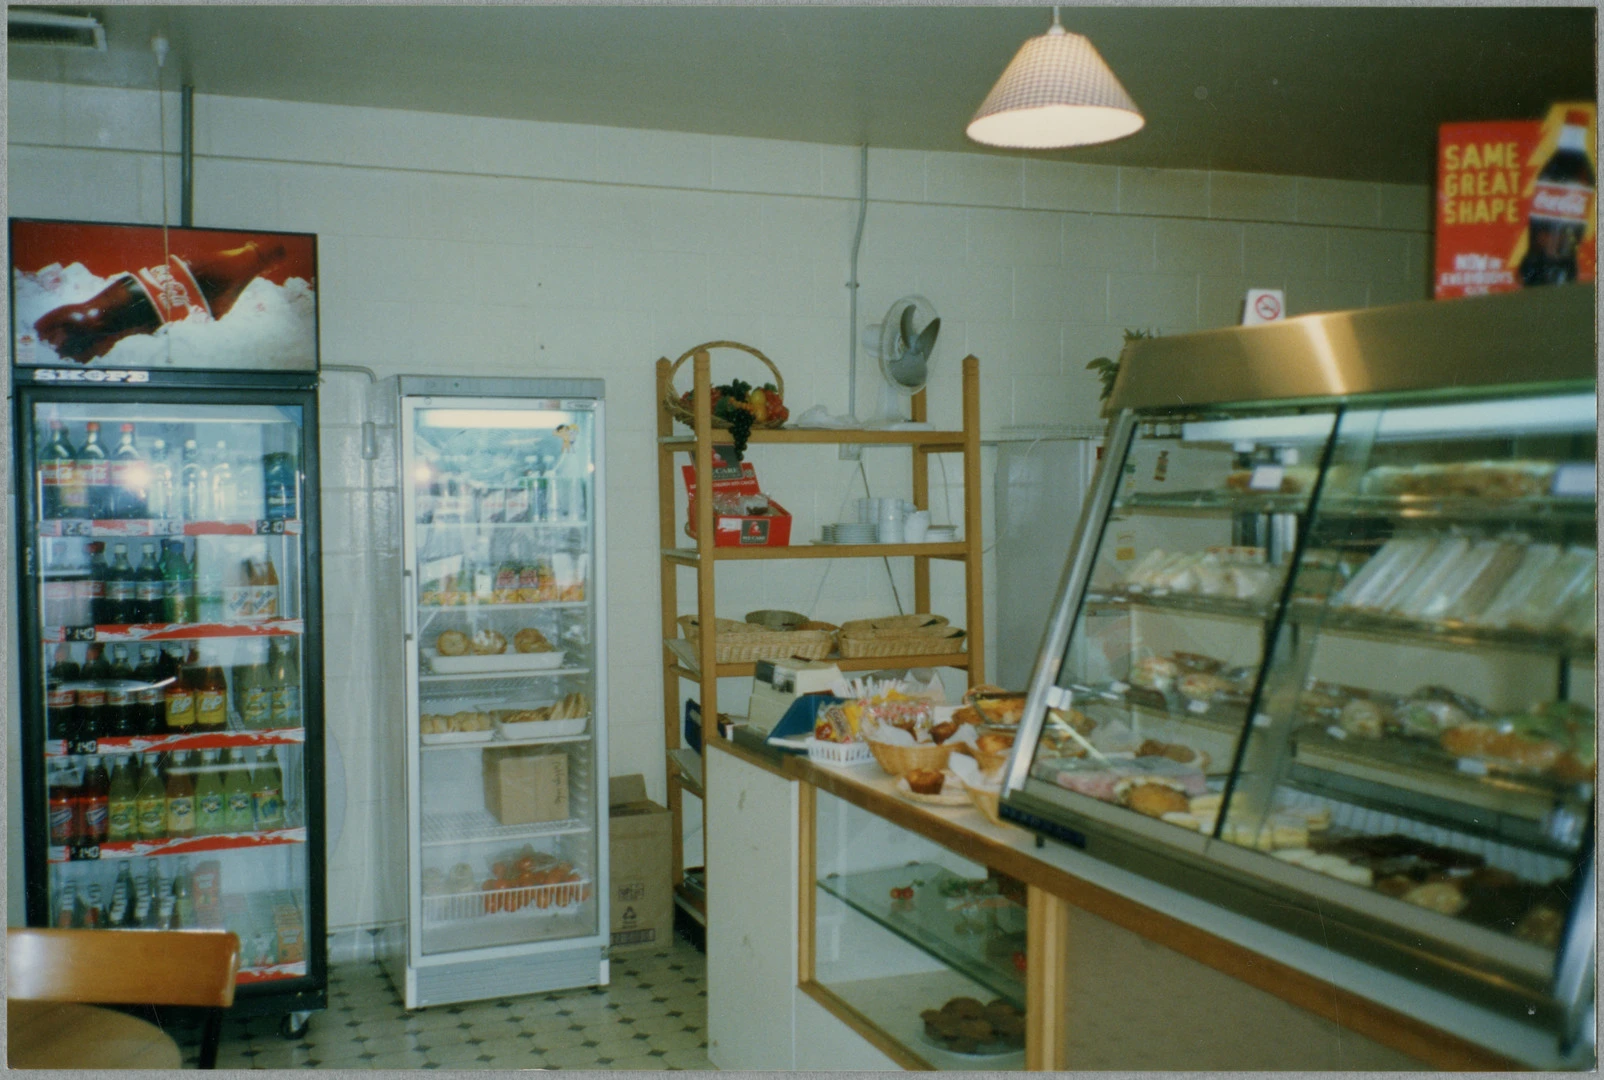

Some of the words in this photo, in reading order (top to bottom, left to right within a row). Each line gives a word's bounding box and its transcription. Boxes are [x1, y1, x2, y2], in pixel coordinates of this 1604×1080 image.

[1444, 144, 1520, 170] SAME
[1444, 172, 1520, 197] GREAT
[1444, 199, 1519, 224] SHAPE
